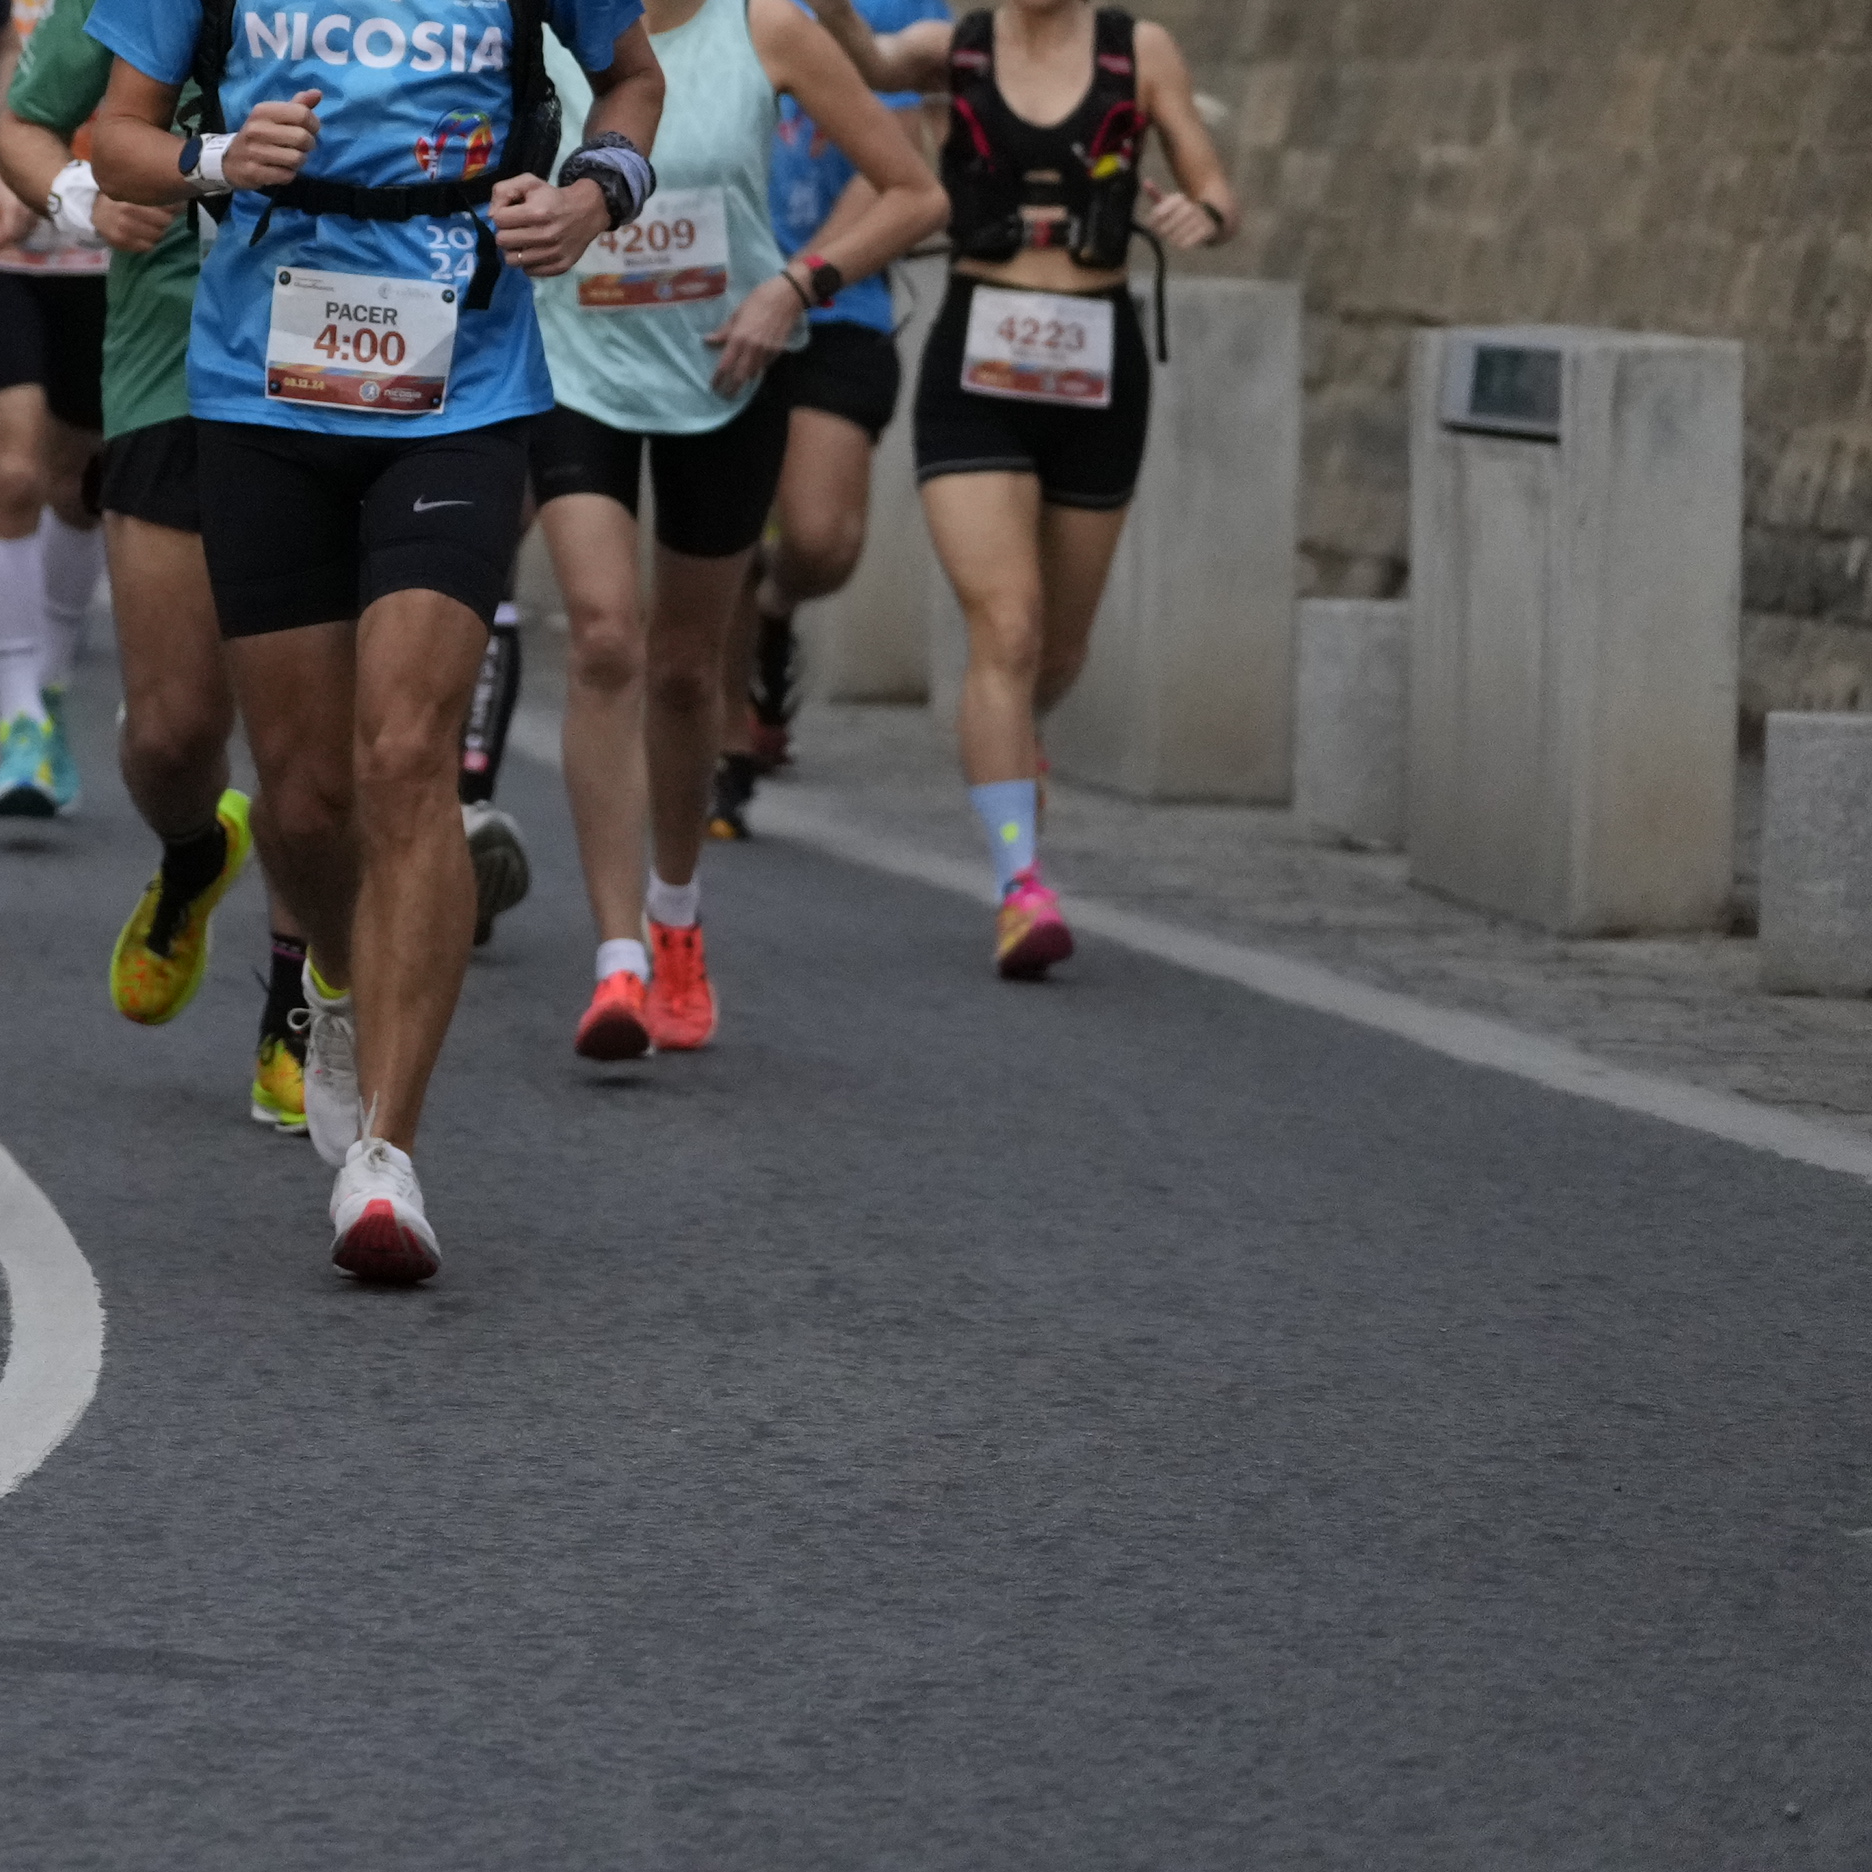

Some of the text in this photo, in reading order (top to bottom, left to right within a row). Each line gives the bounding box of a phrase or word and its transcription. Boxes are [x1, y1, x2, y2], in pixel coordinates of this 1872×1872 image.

[244, 11, 504, 74] NICOSIA
[427, 224, 475, 250] 20
[597, 218, 696, 254] 4209
[430, 252, 475, 280] 24
[325, 301, 398, 325] PACER
[313, 324, 406, 367] 4:00
